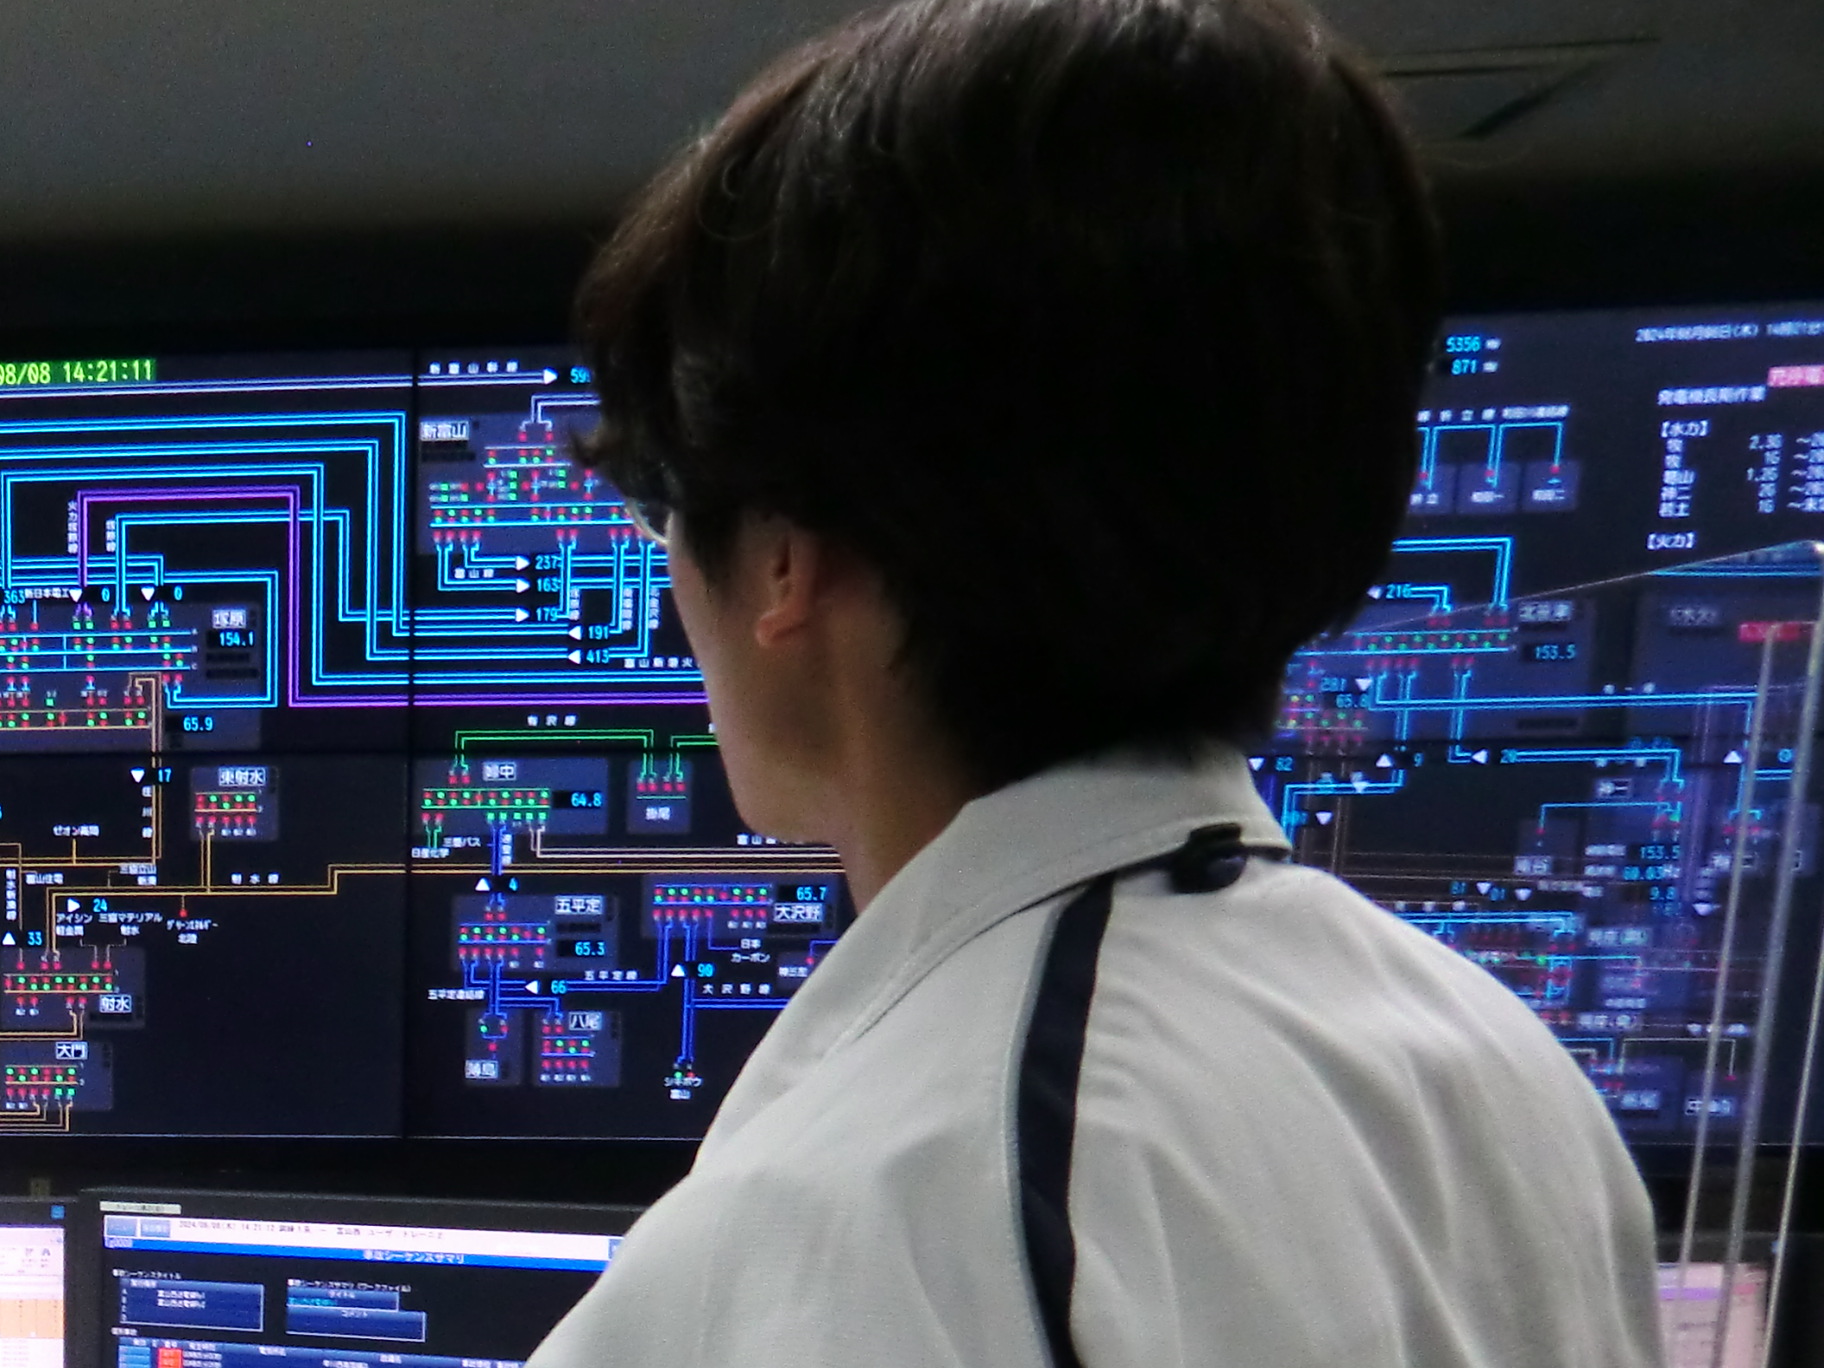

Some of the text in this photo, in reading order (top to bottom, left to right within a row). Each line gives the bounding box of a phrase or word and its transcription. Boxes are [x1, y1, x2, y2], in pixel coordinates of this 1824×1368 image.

[1446, 337, 1481, 352] 5356
[63, 361, 153, 382] 14:21:11
[1452, 360, 1476, 374] 871
[535, 556, 557, 570] 237
[174, 586, 183, 600] 0
[536, 579, 558, 593] 163
[4, 590, 25, 604] 363
[101, 588, 111, 602] 0
[588, 625, 609, 639] 191
[219, 632, 254, 647] 154.1
[586, 651, 609, 664] 413
[184, 717, 213, 732] 65.9
[219, 768, 266, 785] 東射水
[508, 878, 518, 891] 4
[796, 887, 826, 900] 65.7
[93, 899, 108, 913] 24
[556, 898, 602, 914] 五平定
[774, 905, 822, 921] 大沢野
[56, 913, 93, 924] アイシン
[28, 931, 42, 945] 33
[741, 939, 760, 949] 日本
[575, 941, 605, 956] 65.3
[731, 952, 770, 963] カーボン
[698, 963, 713, 977] 90
[551, 980, 567, 994] 66
[100, 995, 131, 1012] 射水
[570, 1014, 601, 1029] 八尾
[56, 1043, 88, 1059] 大門
